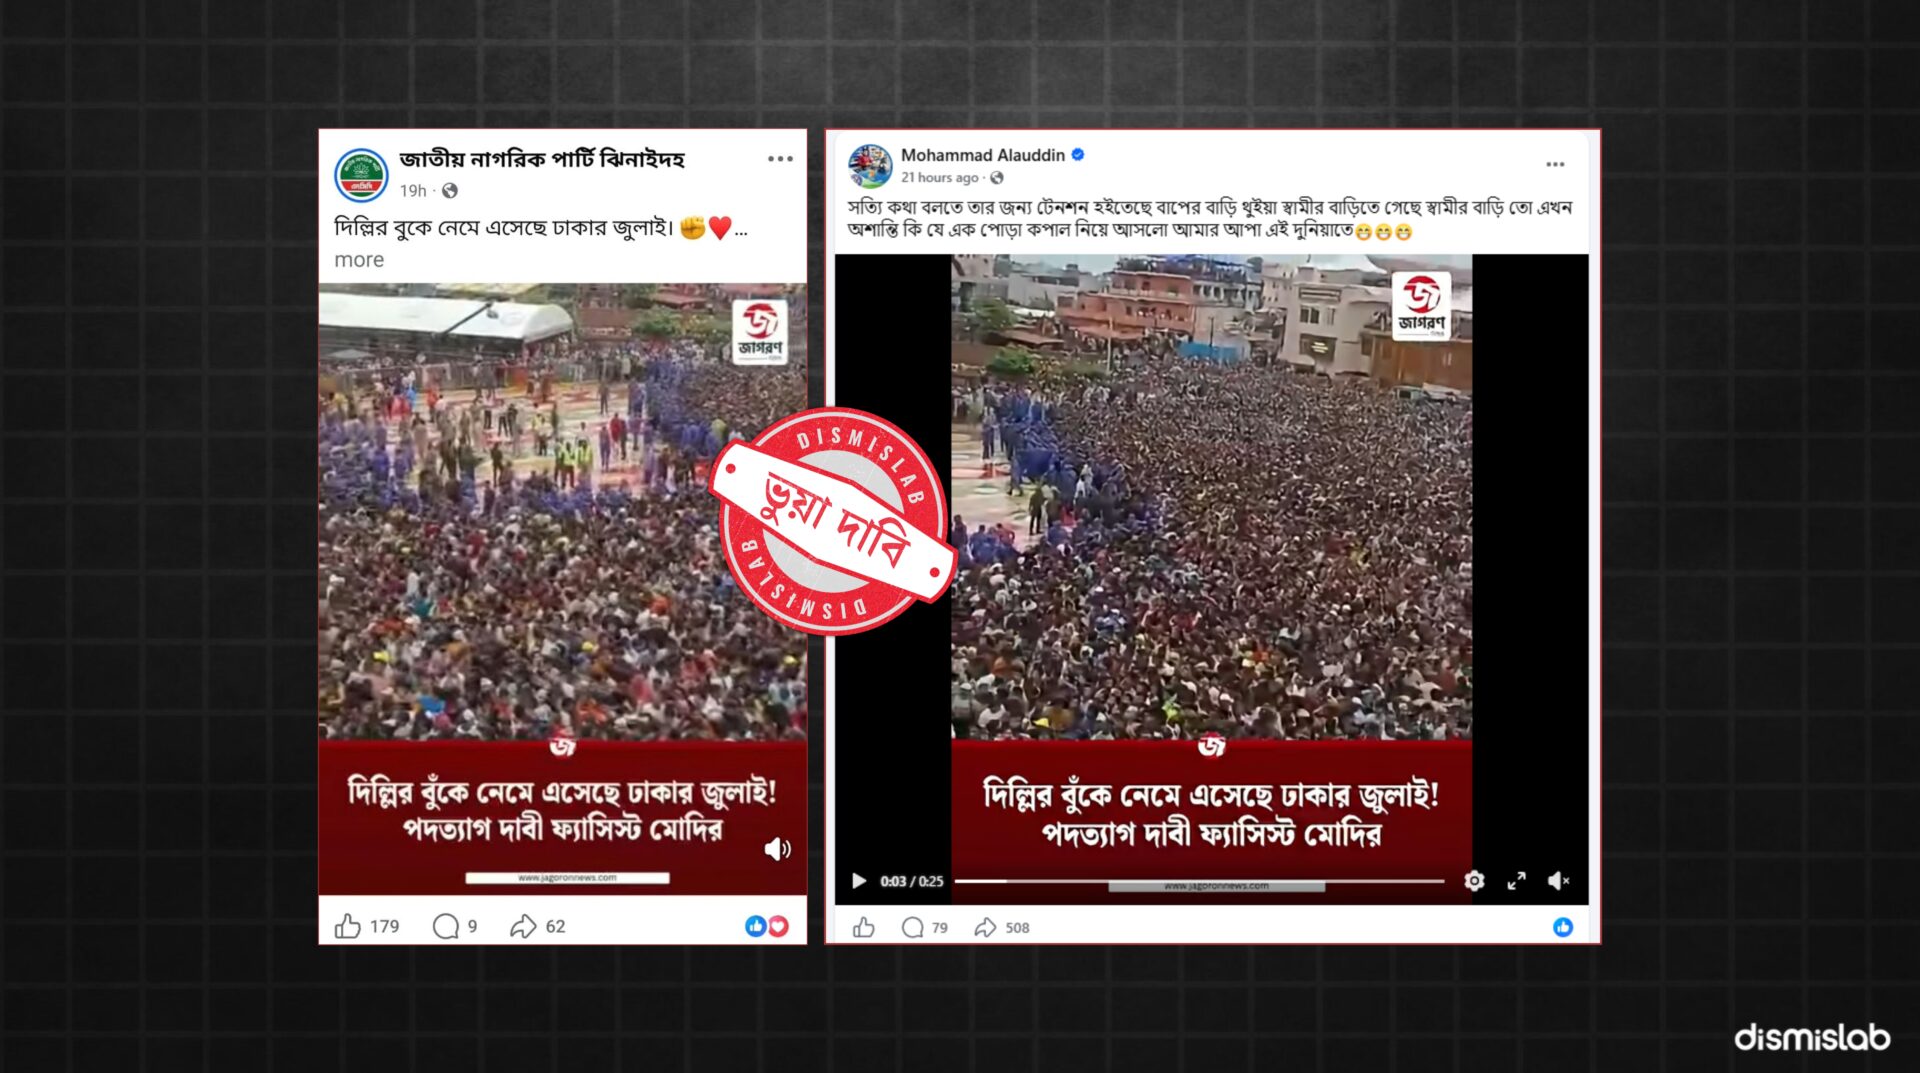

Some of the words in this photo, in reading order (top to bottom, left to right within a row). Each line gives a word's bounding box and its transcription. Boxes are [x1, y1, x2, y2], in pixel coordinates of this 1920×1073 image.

[400, 147, 465, 169] জাতীয়
[471, 147, 546, 168] নাগরিক
[551, 147, 595, 168] পার্টি
[600, 147, 686, 169] ঝিনাইদহ
[901, 148, 993, 162] Mohammad
[998, 148, 1066, 162] Alauddin
[901, 171, 915, 184] 21
[918, 171, 953, 184] hours
[955, 174, 980, 187] ago
[400, 183, 427, 198] 19h
[848, 196, 883, 215] সত্যি
[886, 201, 917, 216] কথা
[921, 201, 963, 215] বলতে
[967, 201, 995, 215] তার
[999, 201, 1032, 216] জন্য
[1037, 197, 1089, 216] টেনশন
[1093, 197, 1152, 217] হইতেছে
[1156, 201, 1201, 215] বাপের
[1205, 196, 1238, 217] বাড়ি
[1242, 198, 1278, 218] থুইয়া
[1282, 196, 1324, 216] স্বামীর
[1328, 196, 1380, 217] বাড়িতে
[1385, 201, 1422, 217] গেছে
[1426, 196, 1468, 216] স্বামীর
[1472, 196, 1505, 217] বাড়ি
[1509, 201, 1533, 215] তো
[1537, 201, 1573, 215] এখন
[333, 215, 388, 238] দিল্লির
[393, 219, 432, 241] বুকে
[438, 219, 480, 237] নেমে
[486, 220, 548, 238] এসেছে
[552, 218, 607, 237] ঢাকার
[612, 215, 673, 240] জুলাই।
[847, 219, 899, 239] অশান্তি
[903, 219, 922, 237] কি
[928, 223, 944, 238] যে
[948, 223, 976, 238] এক
[981, 223, 1022, 241] পোড়া
[1027, 223, 1071, 237] কপাল
[1075, 219, 1109, 238] নিয়ে
[1112, 223, 1168, 238] আসলো
[1172, 223, 1219, 238] আমার
[1223, 223, 1262, 238] আপা
[1266, 219, 1289, 238] এই
[1292, 219, 1354, 241] দুনিয়াতে
[335, 254, 385, 268] more
[880, 875, 907, 888] 0:03
[918, 875, 944, 888] 0:25
[370, 919, 400, 934] 179
[467, 919, 478, 934] 9
[545, 919, 566, 934] 62
[932, 922, 949, 934] 79
[1006, 922, 1030, 934] 508
